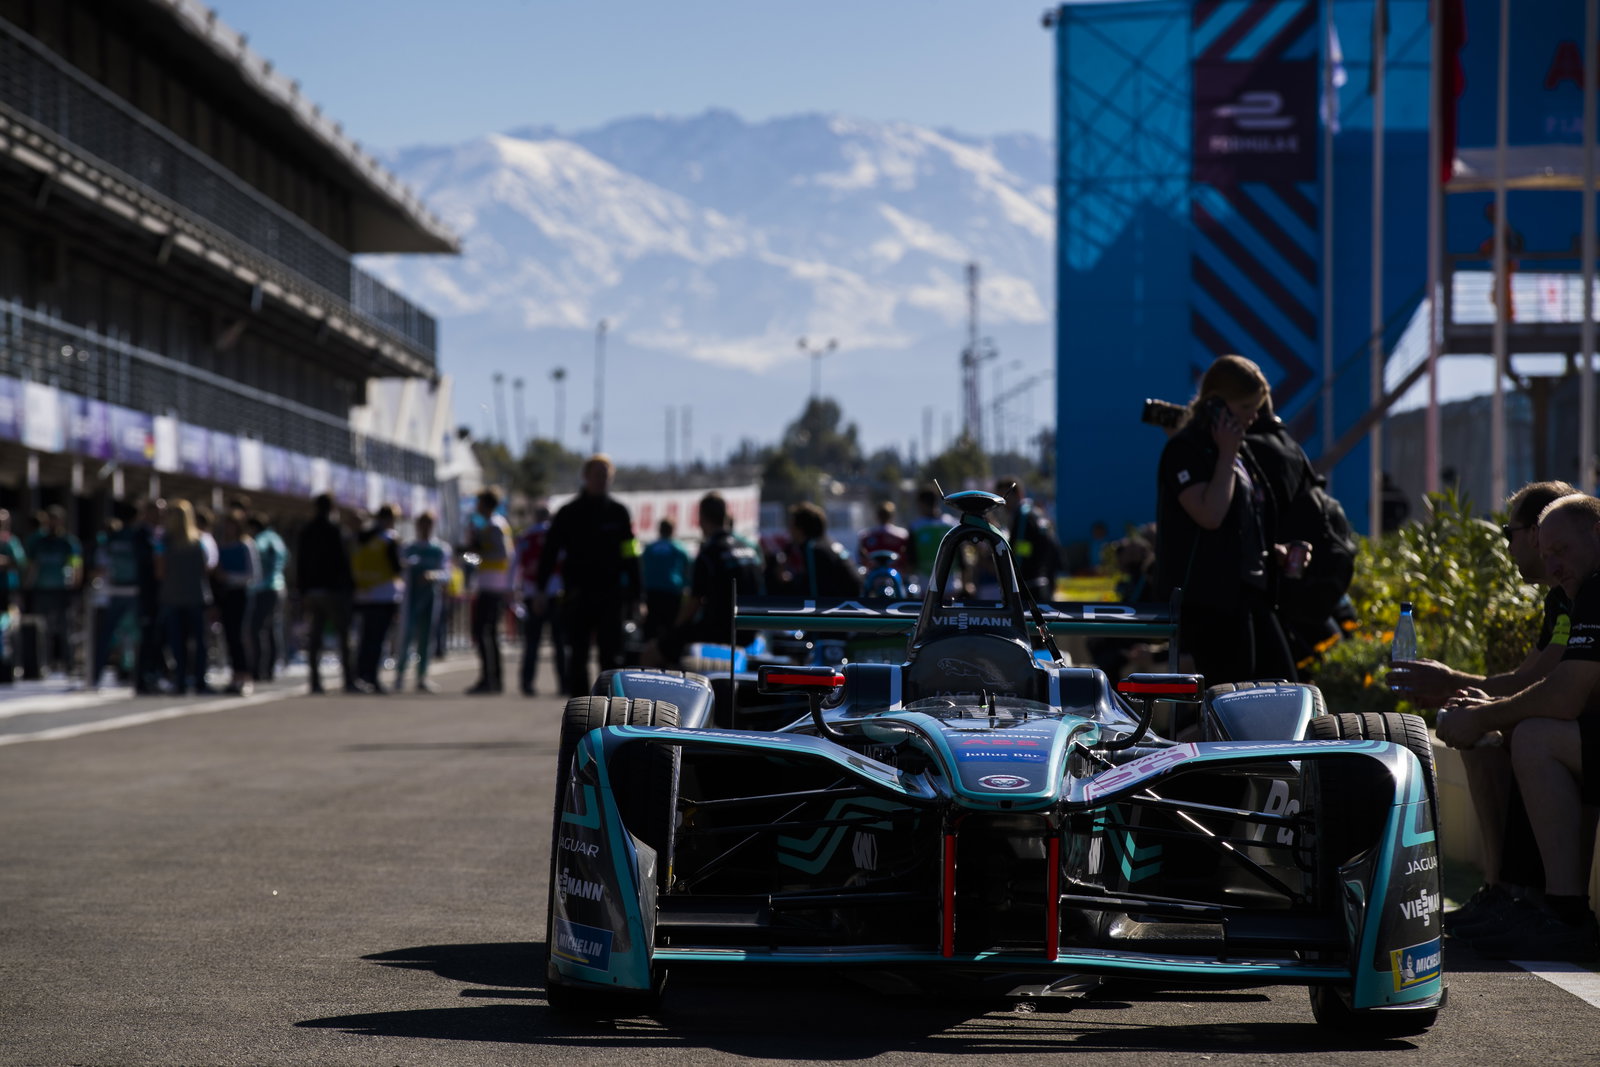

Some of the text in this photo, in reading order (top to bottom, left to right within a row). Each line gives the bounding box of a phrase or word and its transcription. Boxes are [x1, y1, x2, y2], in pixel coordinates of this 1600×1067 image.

[932, 613, 1012, 629] VIESSMANN
[654, 726, 792, 743] Panasonic
[1212, 740, 1350, 751] Panasonic
[559, 933, 602, 957] MICHELIN
